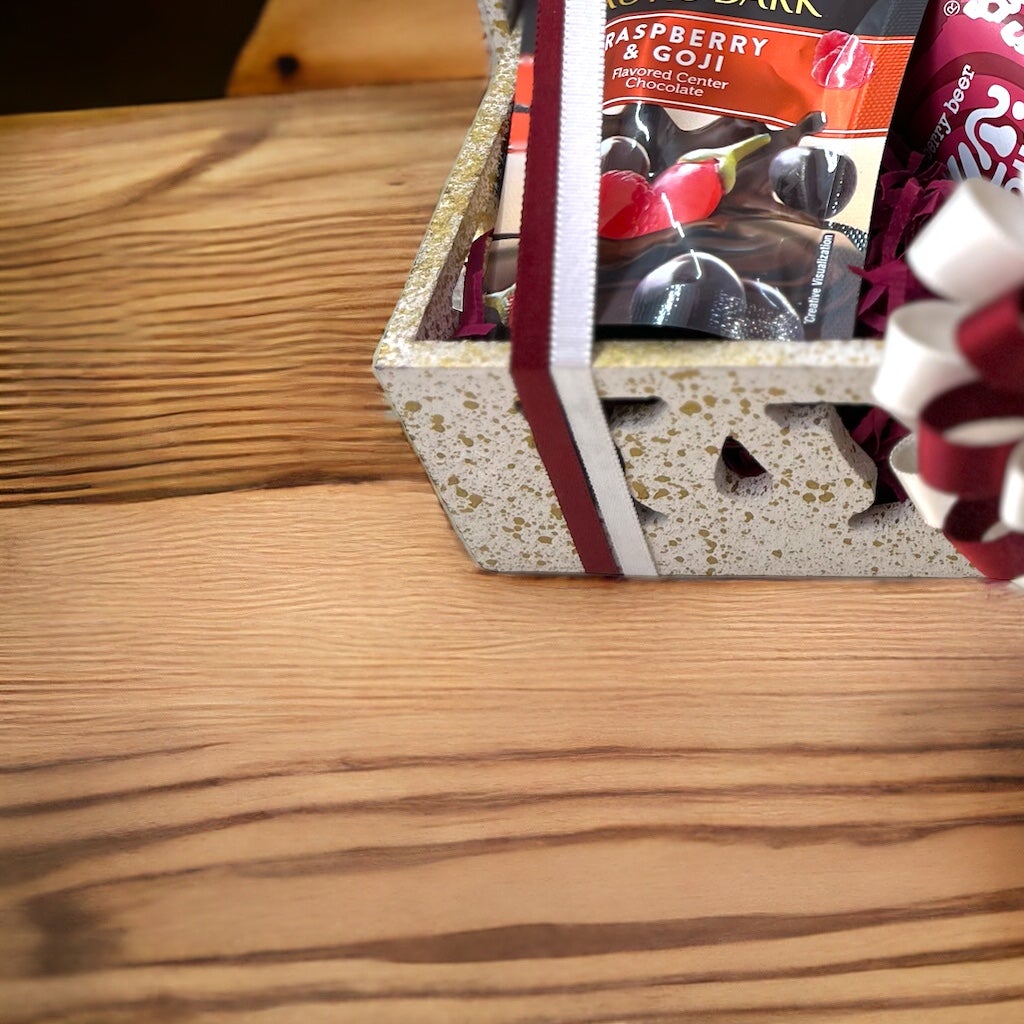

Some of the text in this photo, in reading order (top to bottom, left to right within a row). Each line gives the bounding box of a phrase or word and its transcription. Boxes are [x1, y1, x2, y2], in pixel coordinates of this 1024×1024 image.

[605, 23, 769, 57] RASPBERRY
[622, 43, 725, 72] & GOJI
[612, 66, 729, 90] Flavored Center
[625, 75, 704, 97] Chocolate
[943, 64, 975, 115] beer
[811, 234, 834, 286] Visualization
